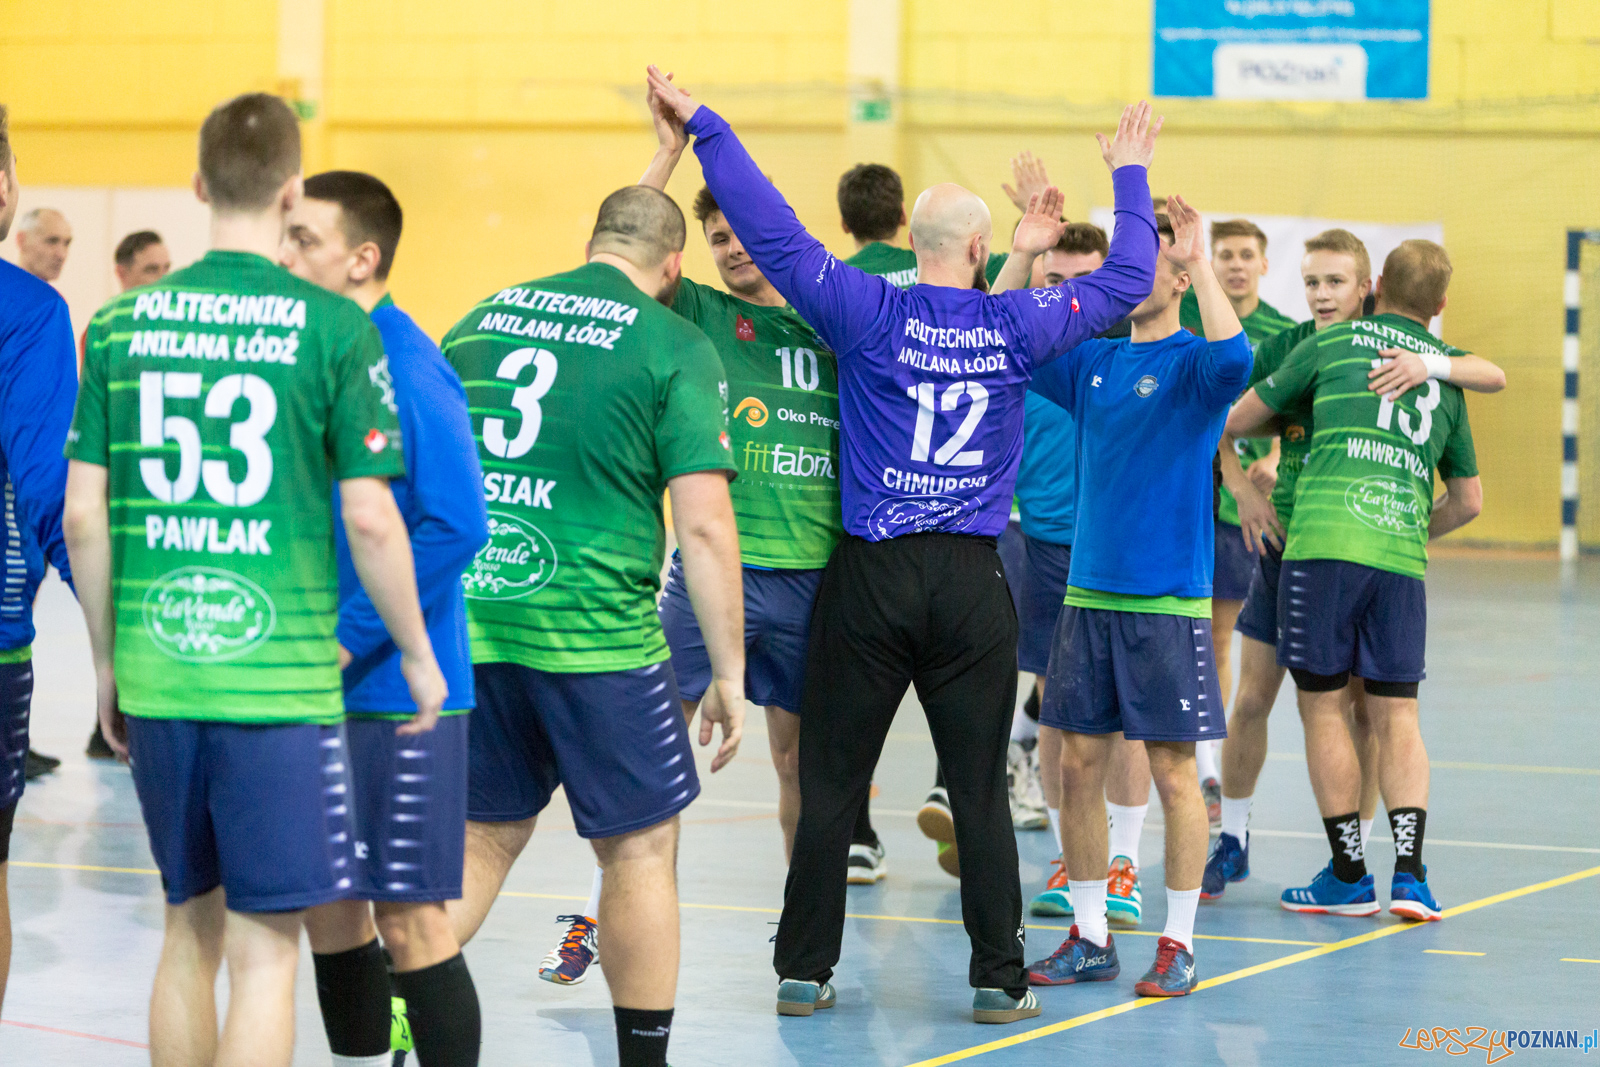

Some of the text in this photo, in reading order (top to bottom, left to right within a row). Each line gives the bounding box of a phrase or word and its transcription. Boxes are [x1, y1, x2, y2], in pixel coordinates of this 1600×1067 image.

[133, 290, 306, 329] POLITECHNIKA
[492, 287, 639, 326] POLITECHNIKA
[128, 327, 299, 365] ANILANA ŁÓDŹ
[477, 312, 623, 350] ANILANA ŁÓDŹ
[905, 317, 1006, 349] POLITECHNIKA
[775, 347, 819, 391] 10
[897, 346, 1007, 374] ANILANA ŁÓDŹ
[482, 347, 558, 459] 3
[777, 408, 806, 423] Oko
[139, 371, 277, 507] 53
[907, 380, 989, 466] 12
[480, 472, 557, 510] SIAK
[145, 514, 272, 555] PAWLAK
